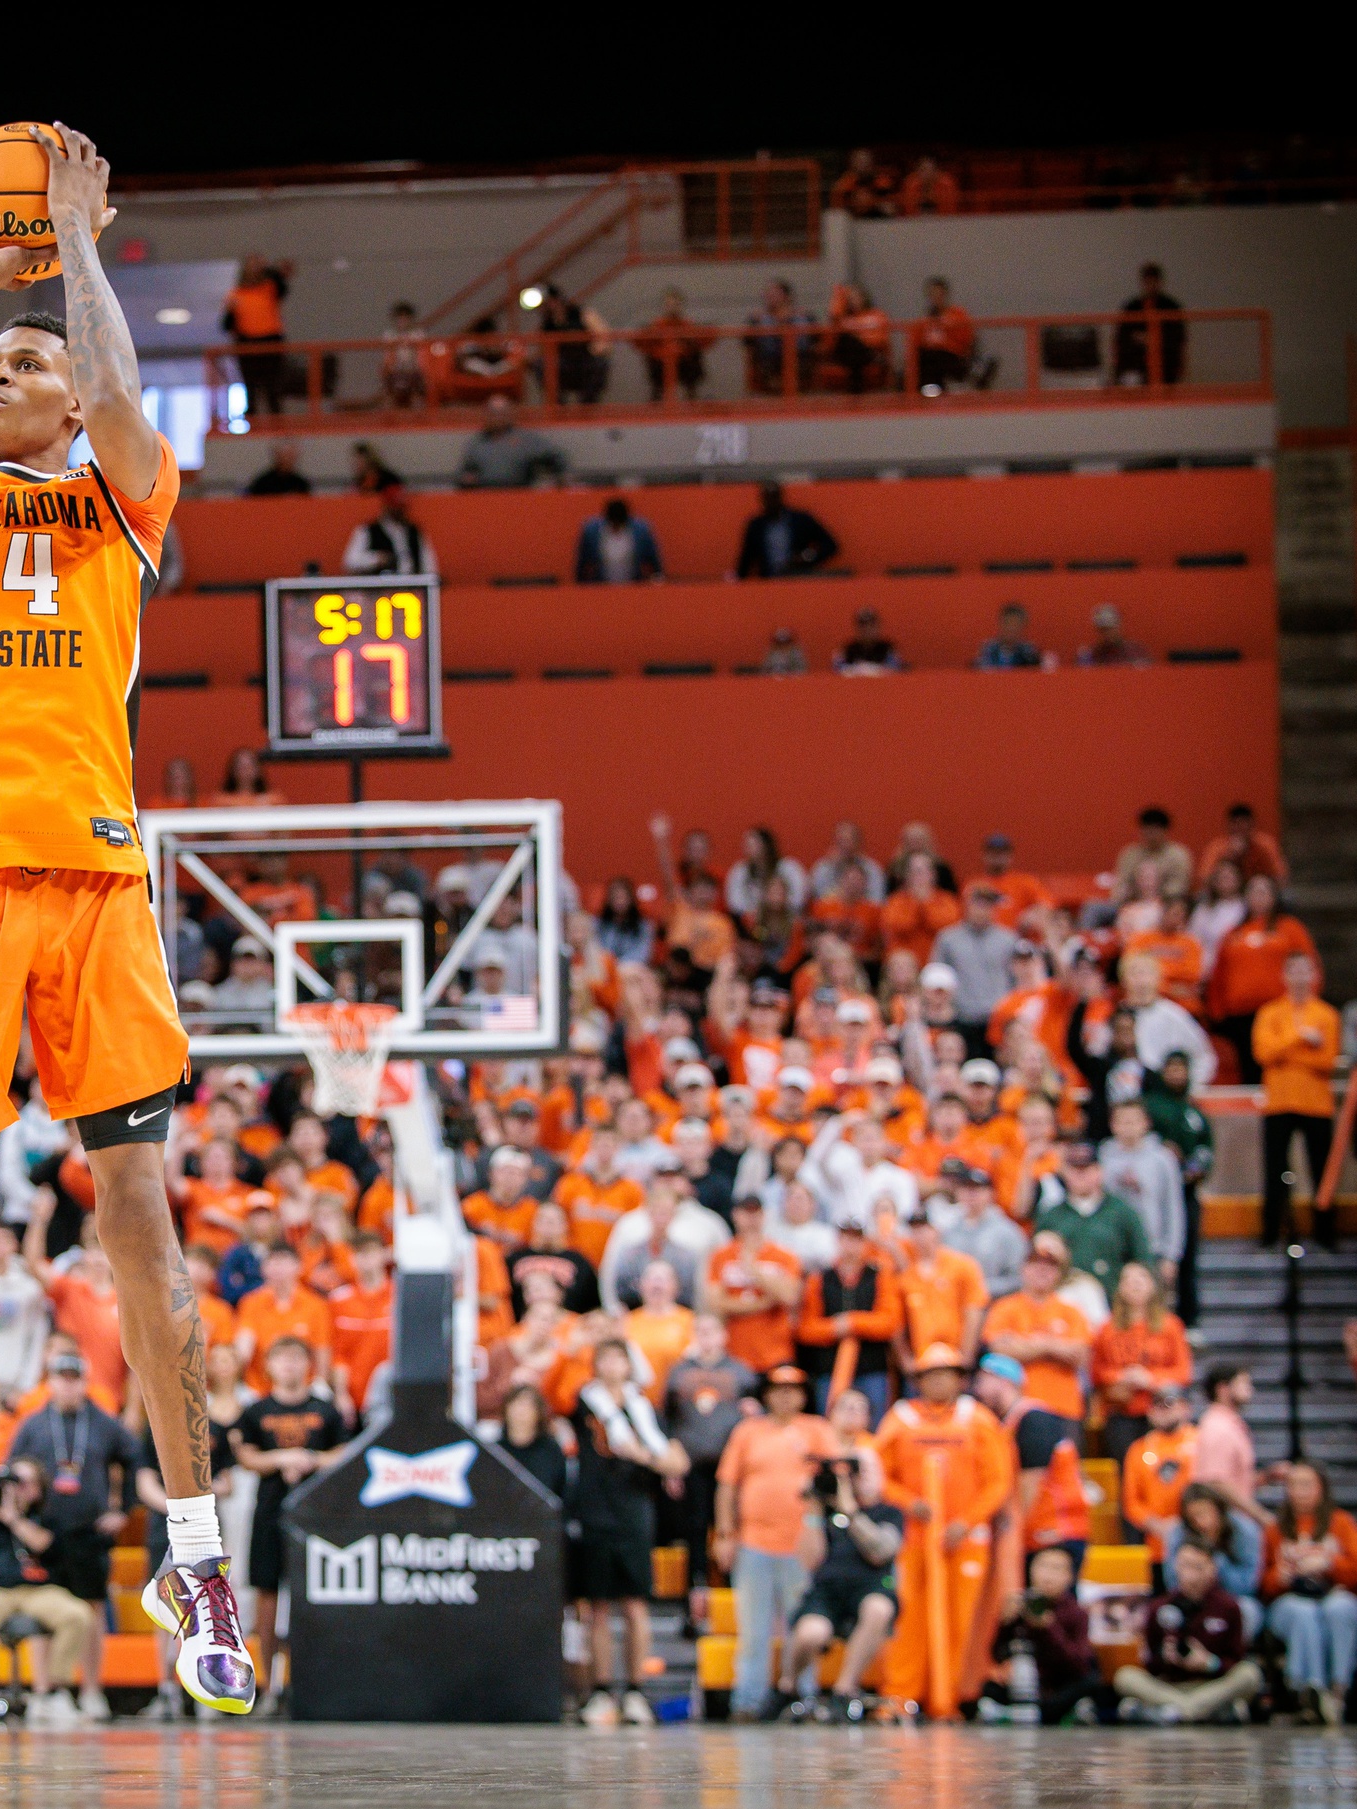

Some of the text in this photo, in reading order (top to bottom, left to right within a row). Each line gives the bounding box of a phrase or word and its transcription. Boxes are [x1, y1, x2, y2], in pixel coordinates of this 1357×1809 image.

[2, 531, 59, 616] 4
[314, 592, 422, 645] 5:17
[333, 643, 410, 727] 17
